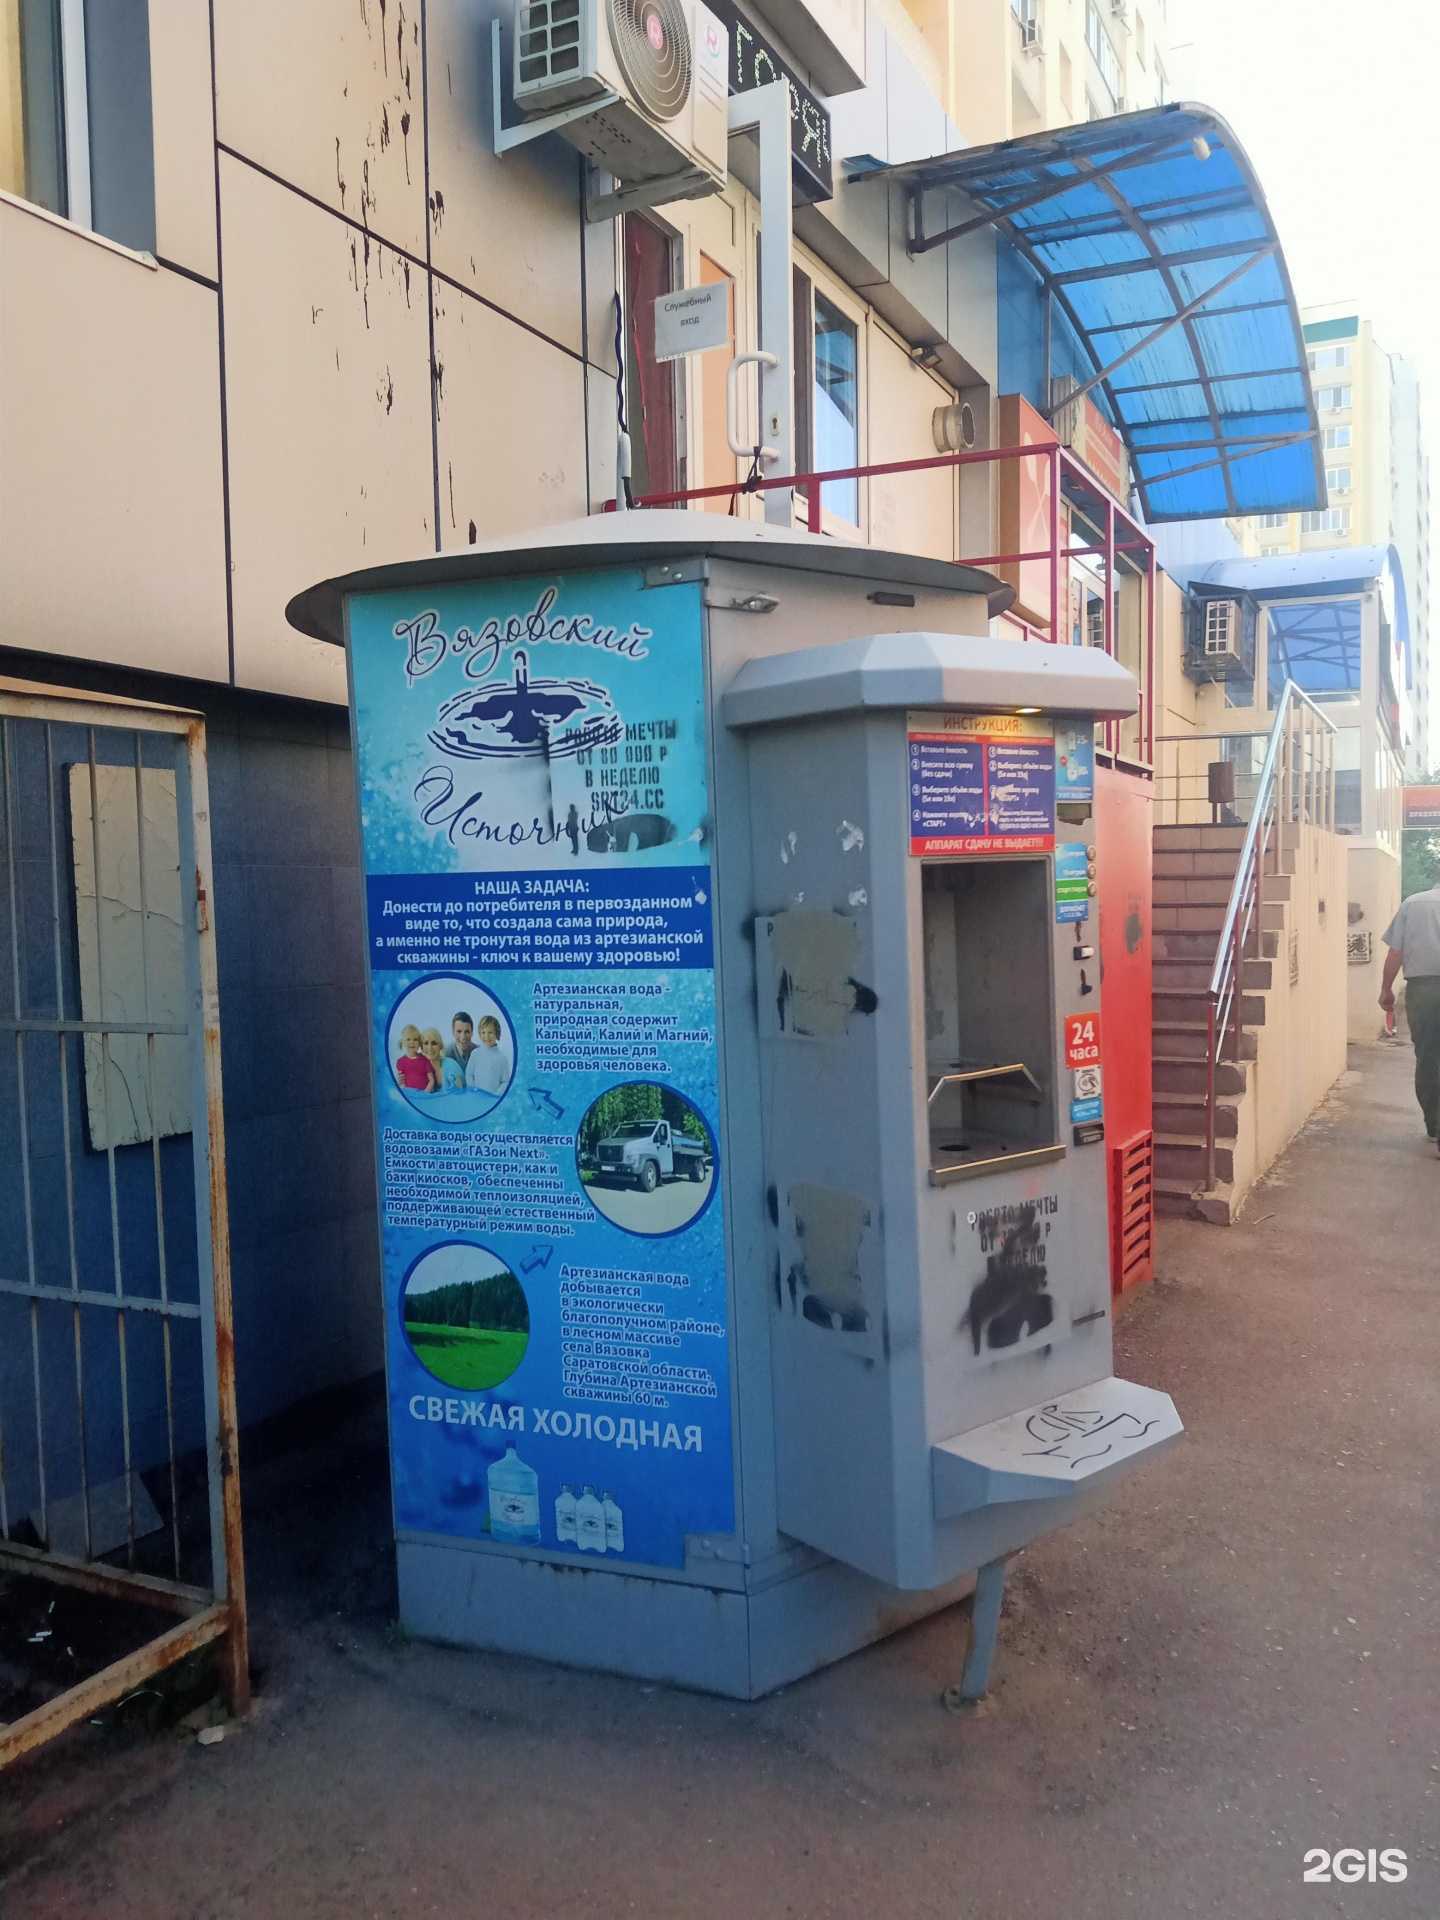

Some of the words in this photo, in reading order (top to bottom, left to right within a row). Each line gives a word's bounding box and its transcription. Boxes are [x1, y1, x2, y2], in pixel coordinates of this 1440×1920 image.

[395, 587, 650, 688] Вязовский
[626, 720, 677, 741] МЕЧТЫ
[577, 748, 592, 765] ОТ
[585, 770, 593, 788] В
[601, 766, 660, 788] НЕДЕЛЮ
[414, 765, 626, 845] Источник
[475, 879, 521, 895] НАША
[524, 879, 590, 897] ЗАДАЧА:
[382, 900, 442, 916] Донести
[445, 901, 463, 915] до
[466, 898, 561, 914] потребителя
[564, 900, 573, 911] в
[576, 896, 693, 913] первозданном
[405, 918, 440, 931] виде
[442, 918, 463, 932] то,
[466, 918, 490, 930] что
[493, 917, 553, 930] создала
[556, 916, 592, 928] сама
[595, 914, 669, 931] природа,
[375, 938, 384, 948] а
[386, 935, 441, 948] именно
[444, 935, 461, 946] не
[463, 934, 531, 949] тронутая
[534, 934, 570, 948] вода
[574, 933, 591, 945] из
[595, 929, 703, 948] артезианской
[397, 951, 470, 964] скважины
[481, 951, 519, 963] ключ
[522, 951, 531, 963] к
[534, 950, 592, 965] вашему
[595, 948, 681, 965] здоровью!
[533, 983, 626, 996] Артезианская
[630, 985, 662, 995] вода
[534, 1001, 623, 1012] натуральная,
[535, 1014, 608, 1026] природная
[611, 1015, 678, 1026] содержит
[535, 1027, 596, 1042] Кальций,
[599, 1028, 641, 1040] Калий
[644, 1031, 653, 1040] и
[656, 1028, 713, 1044] Магний,
[1072, 1020, 1095, 1045] 24
[536, 1044, 629, 1057] необходимые
[631, 1046, 657, 1056] для
[1069, 1045, 1098, 1061] часа
[537, 1060, 600, 1072] здоровья
[603, 1061, 671, 1072] человека.
[384, 1128, 438, 1141] Доставка
[440, 1132, 472, 1143] воды
[474, 1134, 574, 1146] осуществляется
[384, 1145, 460, 1157] водовозами
[385, 1157, 436, 1168] Емкости
[438, 1161, 521, 1174] автоцистерн,
[525, 1164, 546, 1174] как
[549, 1166, 558, 1174] и
[386, 1171, 415, 1182] баки
[417, 1174, 472, 1186] киосков,
[477, 1175, 563, 1189] обеспеченны
[387, 1187, 470, 1200] необходимой
[474, 1191, 584, 1206] теплоизоляцией,
[387, 1201, 501, 1216] поддерживающей
[504, 1207, 595, 1220] естественный
[388, 1215, 487, 1230] температурный
[490, 1221, 533, 1232] режим
[536, 1223, 574, 1235] воды.
[561, 1265, 653, 1283] Артезианская
[657, 1274, 689, 1286] вода
[561, 1281, 641, 1297] добывается
[562, 1299, 569, 1307] в
[572, 1298, 664, 1314] экологически
[562, 1310, 666, 1329] благополучном
[670, 1319, 725, 1336] районе,
[563, 1328, 570, 1336] в
[573, 1329, 622, 1341] лесном
[624, 1333, 680, 1345] массиве
[563, 1343, 591, 1353] села
[595, 1343, 650, 1358] Вязовка
[563, 1355, 649, 1374] Саратовской
[651, 1365, 711, 1380] области.
[564, 1371, 617, 1386] Глубина
[620, 1376, 717, 1396] Артезианской
[564, 1387, 632, 1402] скважины
[635, 1393, 651, 1404] 60
[654, 1397, 669, 1407] м.
[408, 1395, 525, 1431] СВЕЖАЯ
[533, 1408, 703, 1452] ХОЛОДНАЯ
